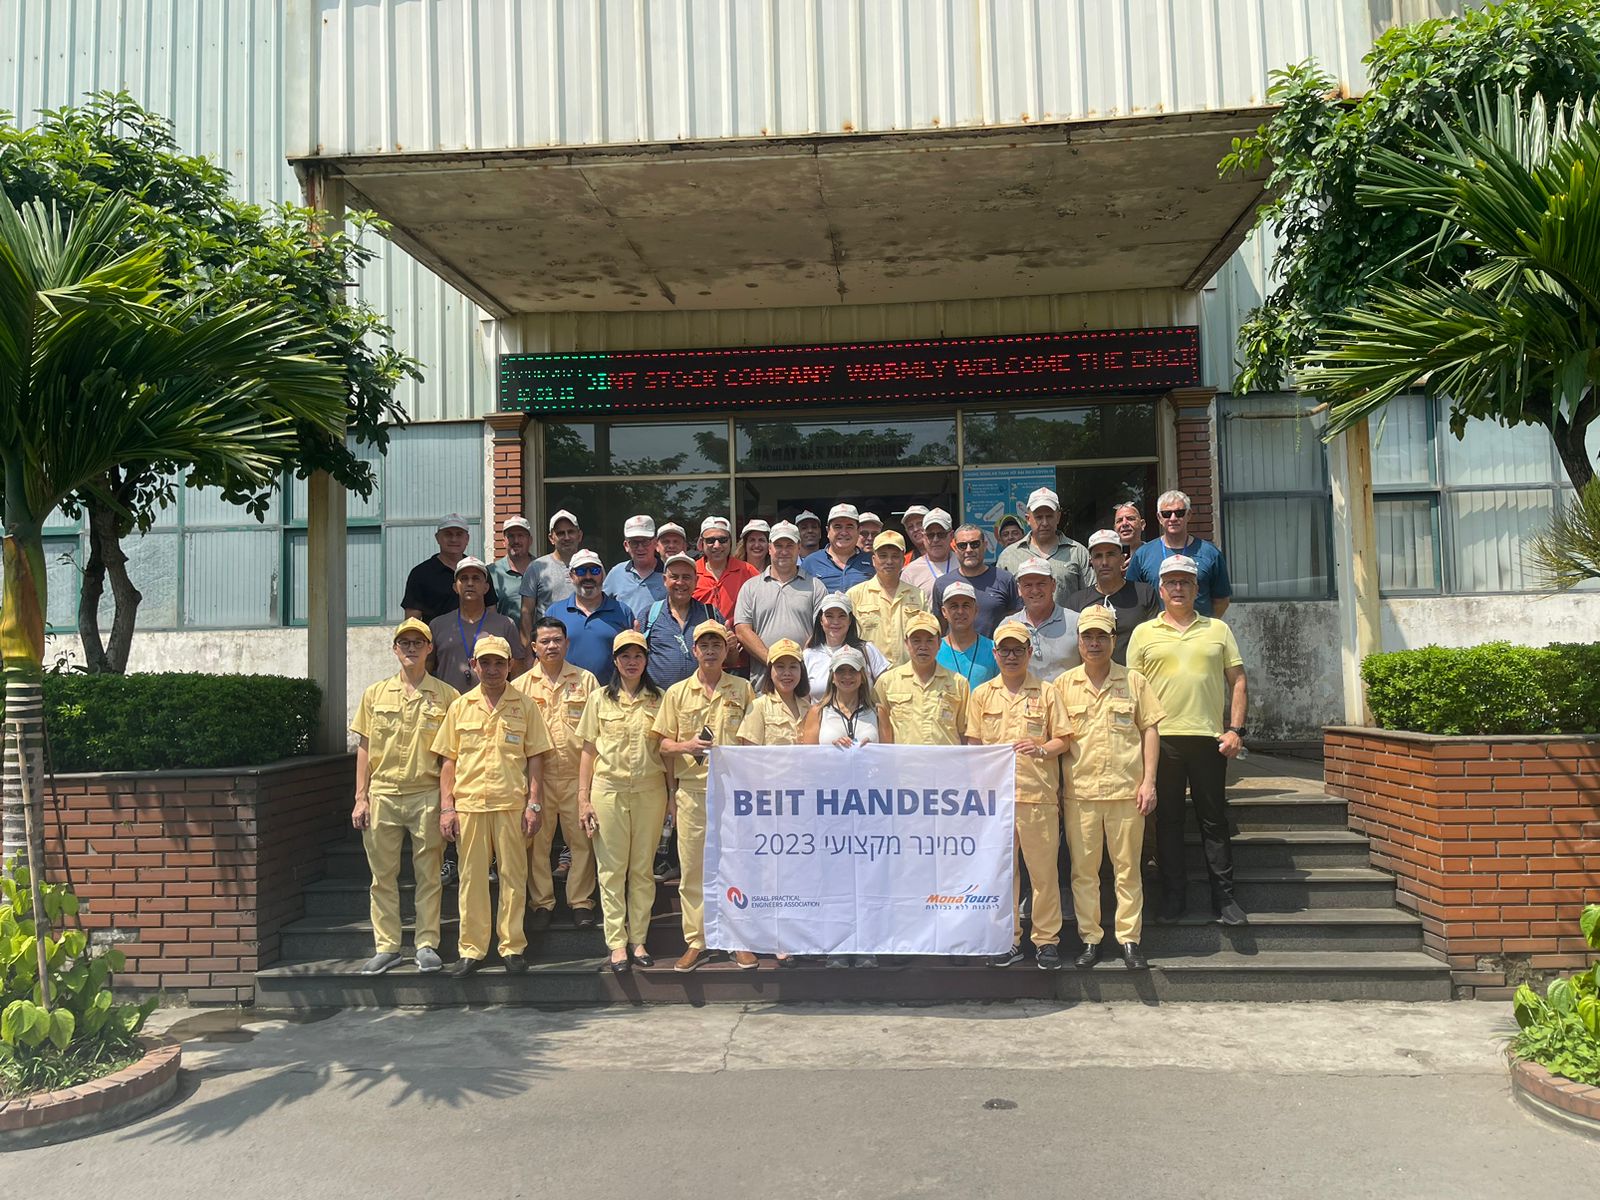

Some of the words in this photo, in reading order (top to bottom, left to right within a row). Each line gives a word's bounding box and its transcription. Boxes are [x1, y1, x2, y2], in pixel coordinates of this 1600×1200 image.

[724, 365, 834, 386] COMPANY
[846, 360, 948, 381] WARMLY
[953, 355, 1070, 376] WELCOME
[733, 789, 805, 816] BEIT
[817, 789, 996, 816] HANDESAI
[754, 833, 815, 856] 2023
[824, 834, 901, 861] מקצועי
[909, 834, 976, 856] סמינר
[927, 894, 1000, 904] MonaTours
